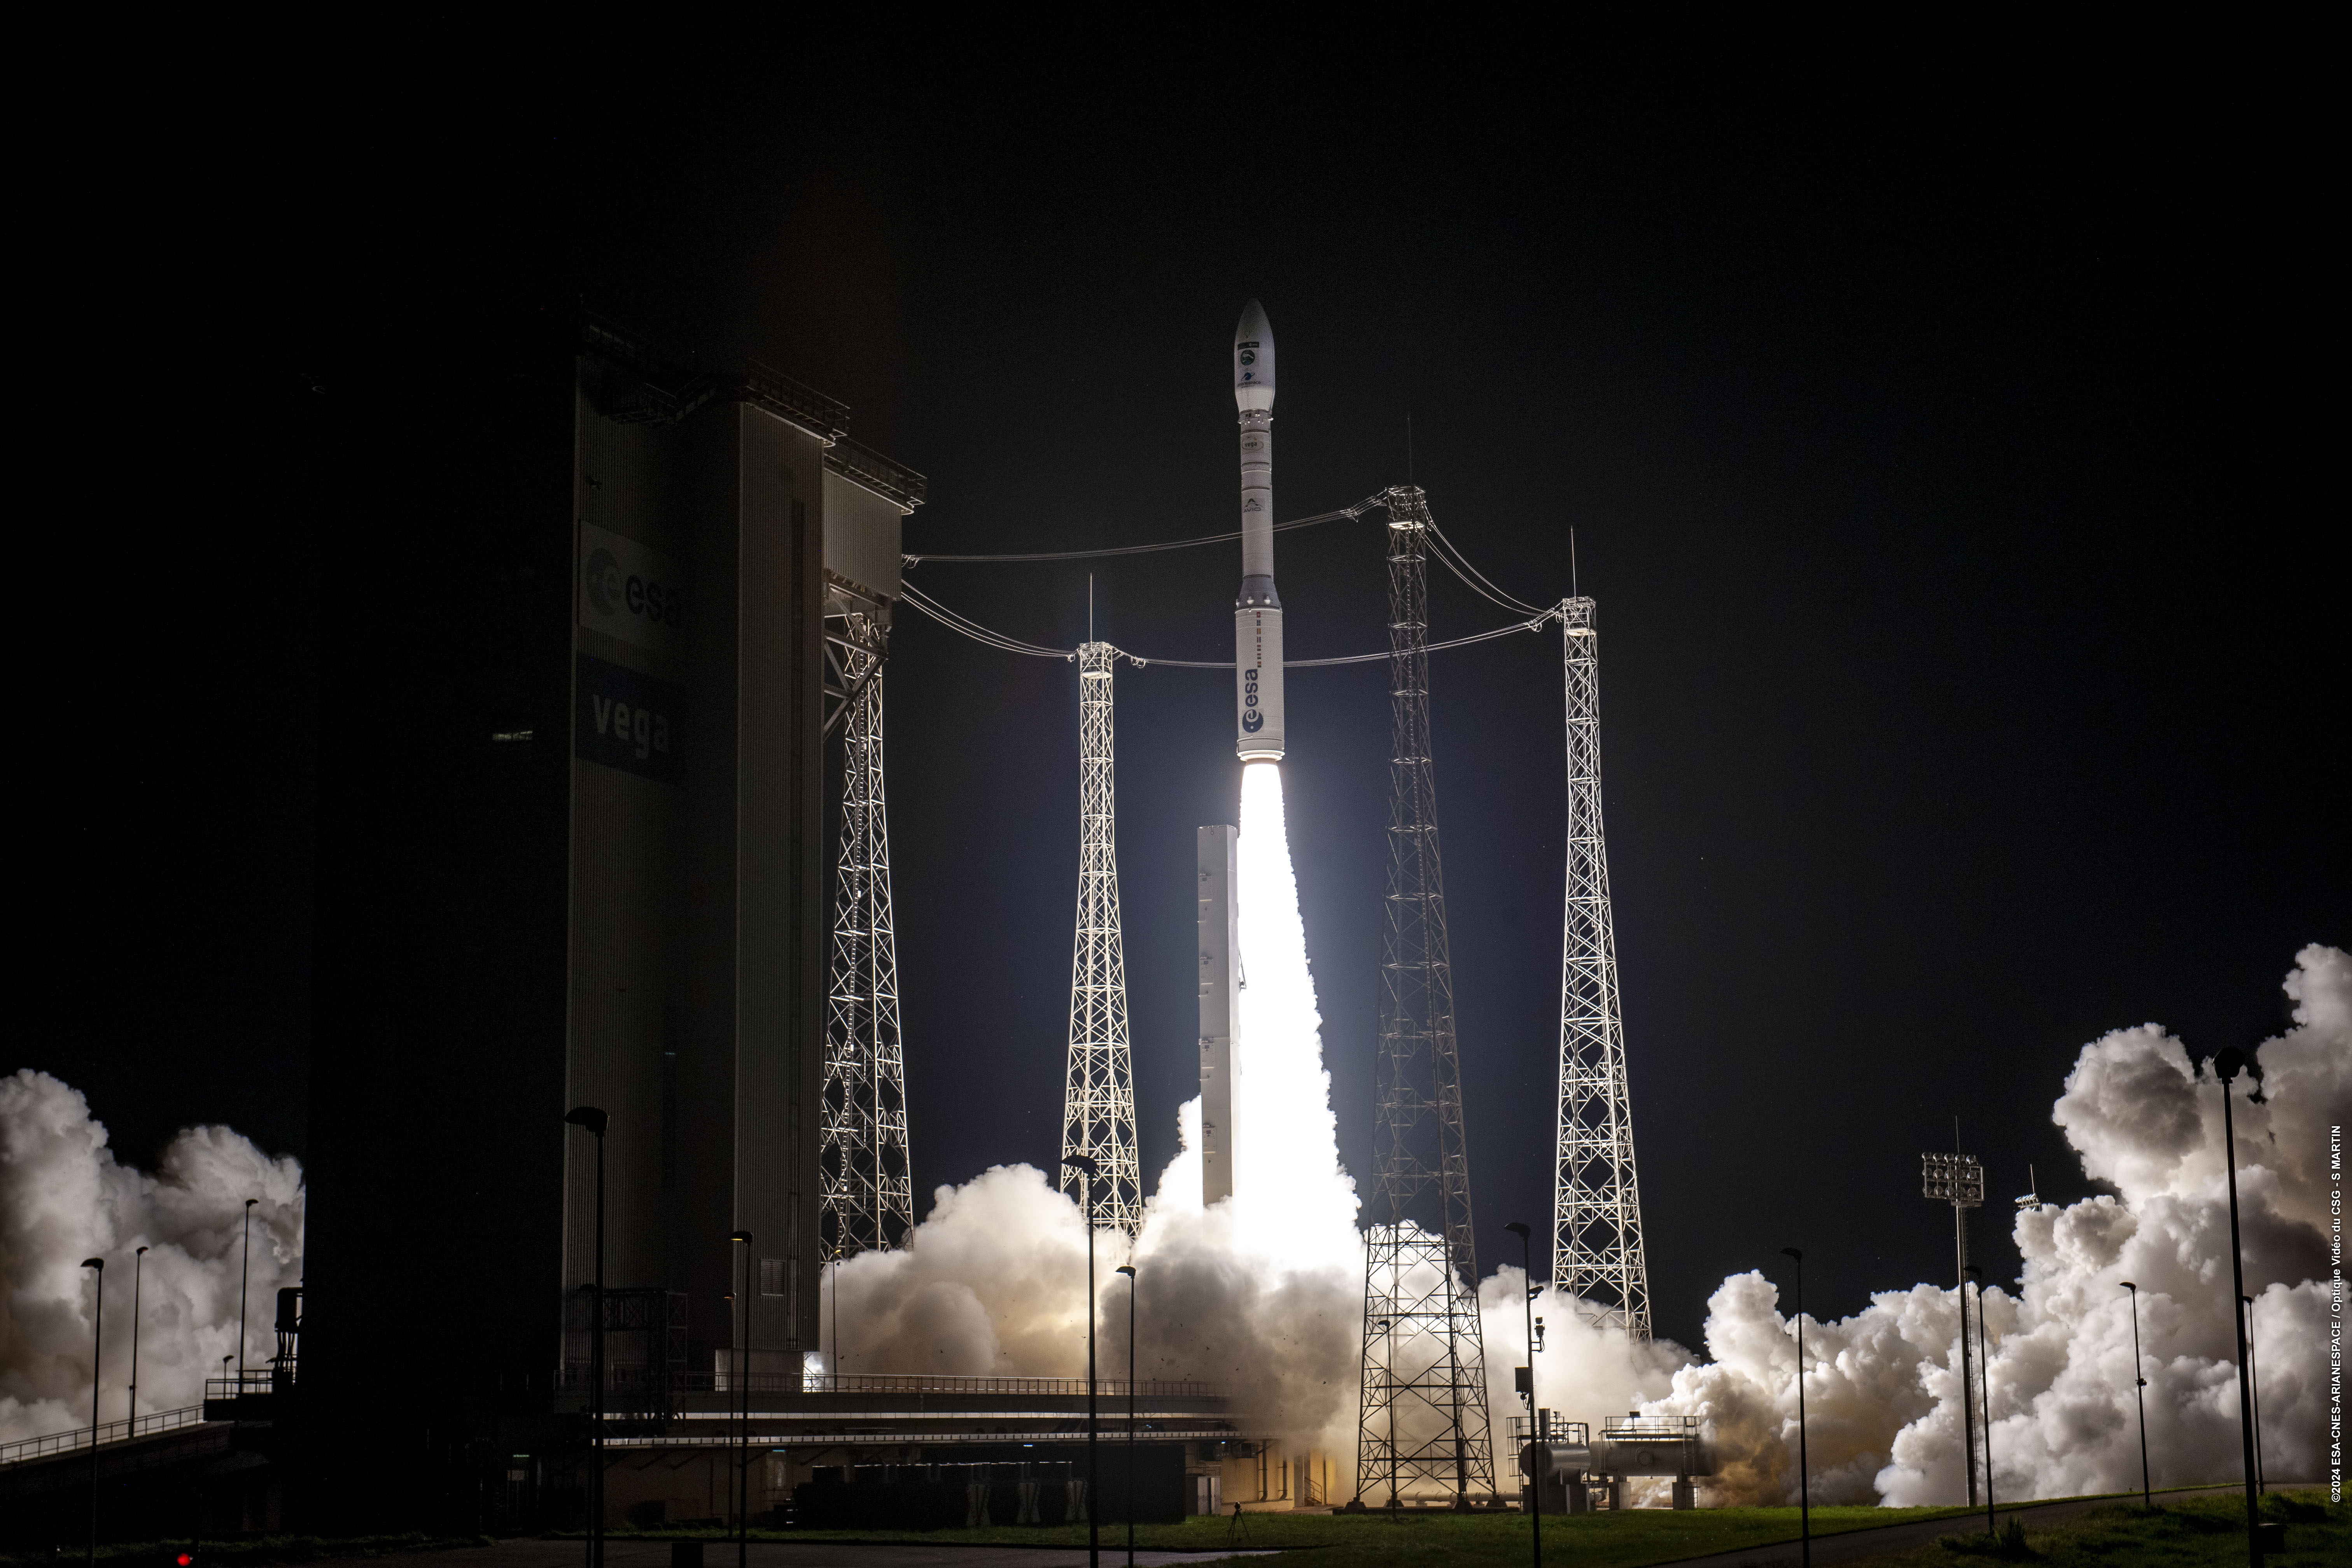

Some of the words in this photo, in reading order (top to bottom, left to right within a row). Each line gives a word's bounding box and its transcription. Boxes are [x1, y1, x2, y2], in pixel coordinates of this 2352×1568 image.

[625, 574, 682, 627] esa
[1245, 668, 1258, 707] esa
[593, 693, 669, 760] vega
